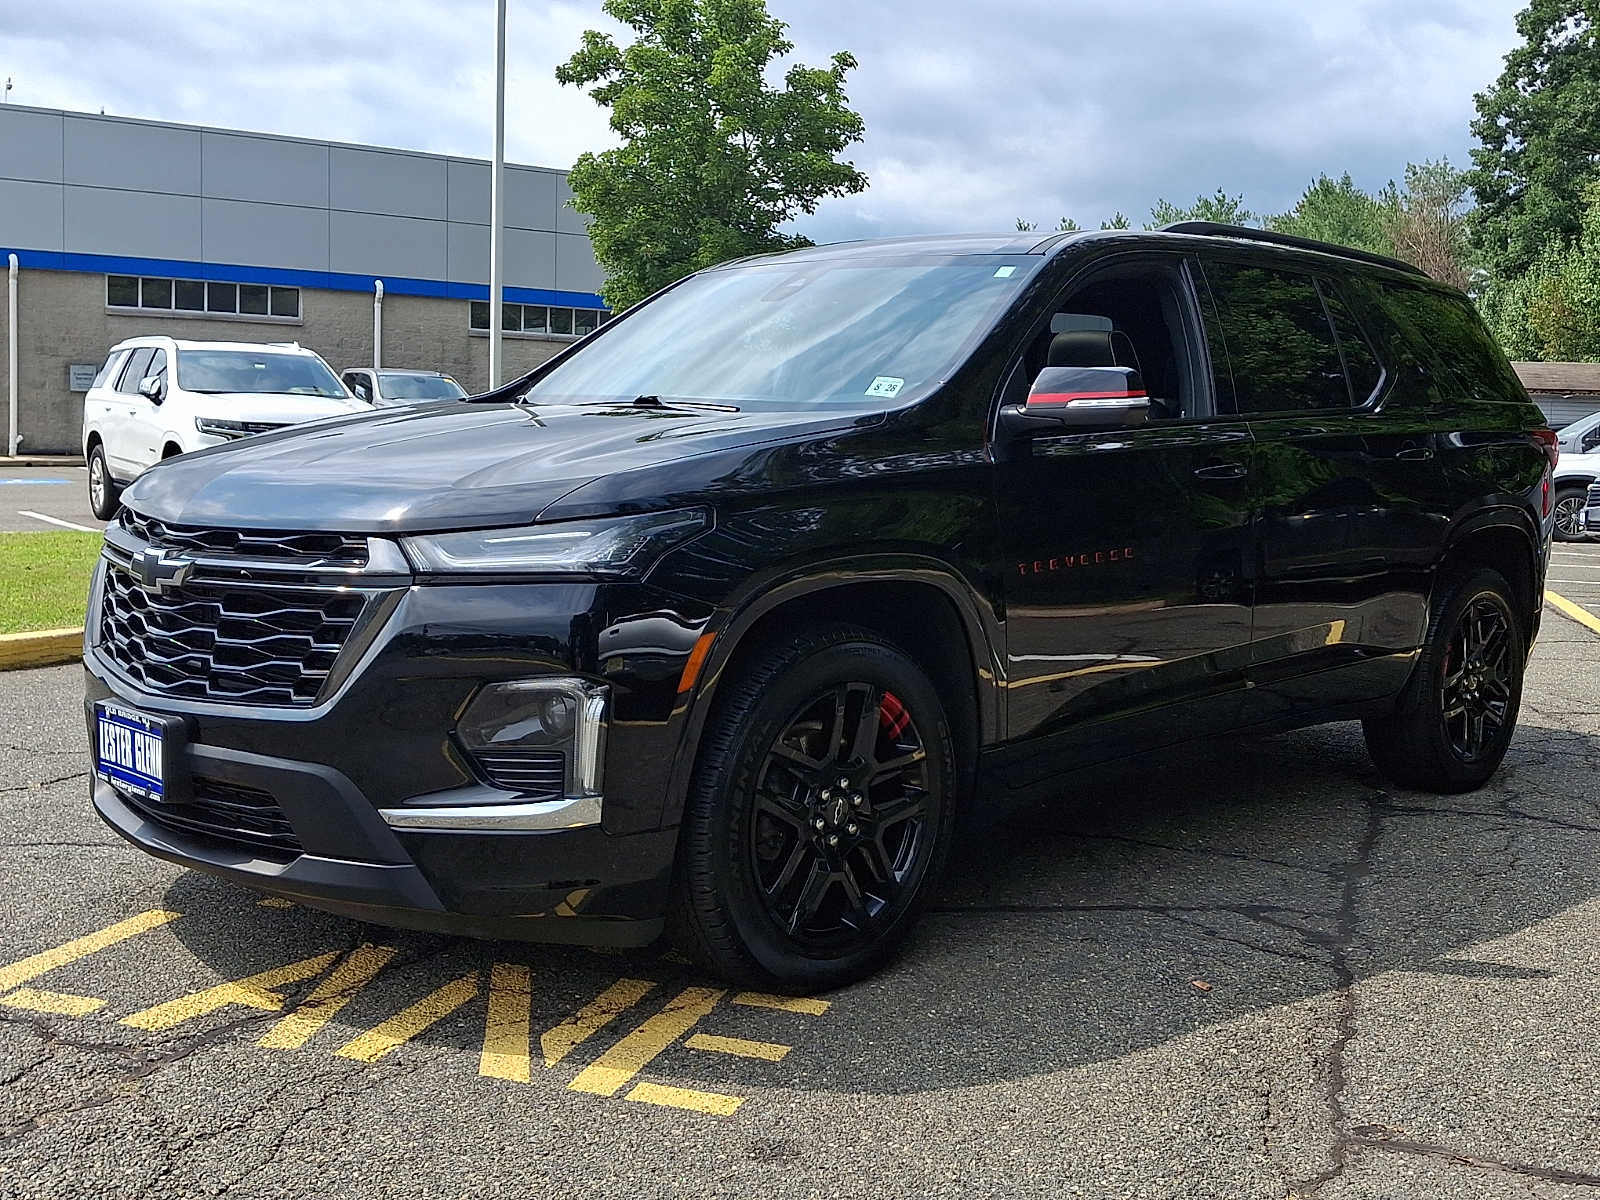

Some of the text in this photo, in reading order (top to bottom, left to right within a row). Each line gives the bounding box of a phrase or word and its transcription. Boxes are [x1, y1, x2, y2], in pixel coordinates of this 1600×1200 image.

[884, 383, 898, 392] 28
[99, 720, 163, 780] LESTER GLENN
[0, 909, 830, 1116] LANE
